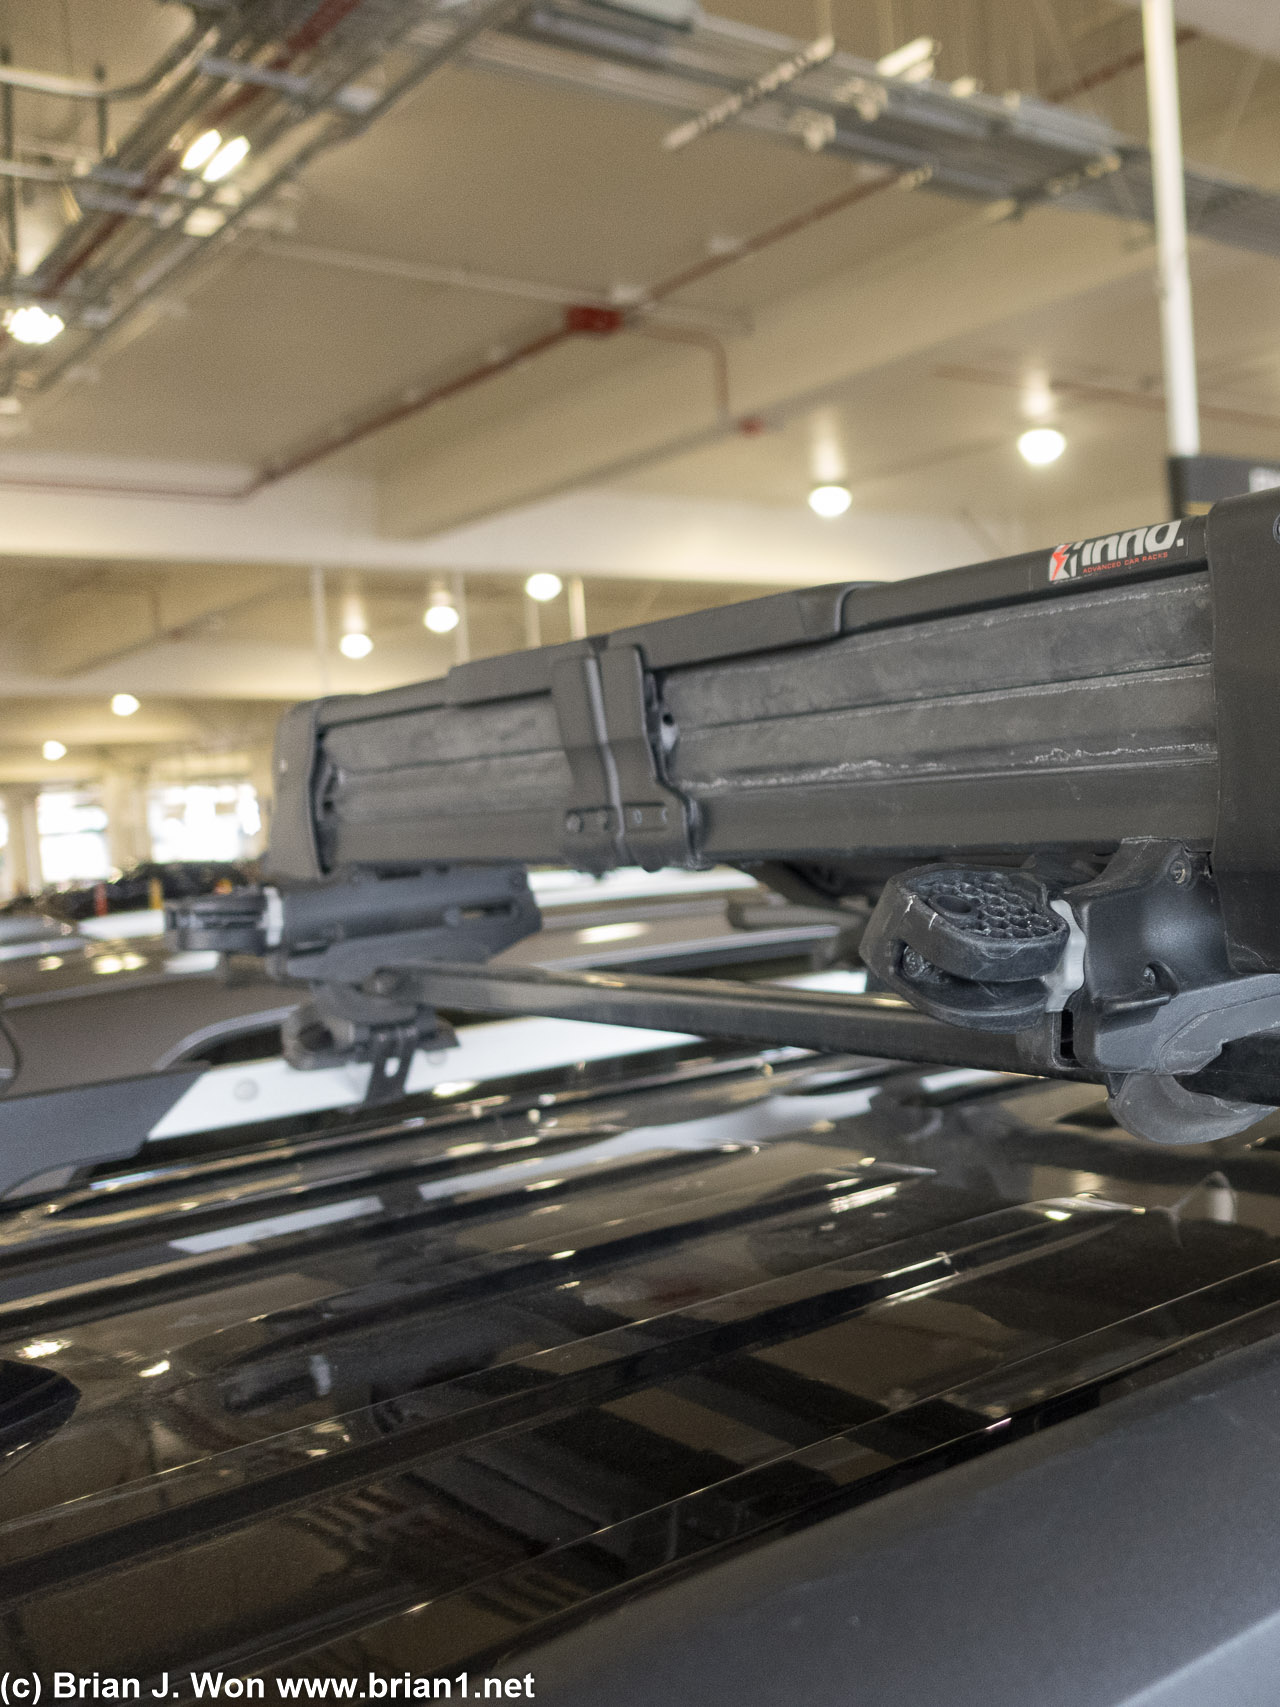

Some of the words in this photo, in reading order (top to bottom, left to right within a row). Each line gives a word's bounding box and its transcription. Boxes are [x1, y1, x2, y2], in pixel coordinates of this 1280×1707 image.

[1082, 562, 1121, 573] ADVANCED
[1124, 557, 1140, 566] CAR
[1142, 550, 1168, 562] RACKS
